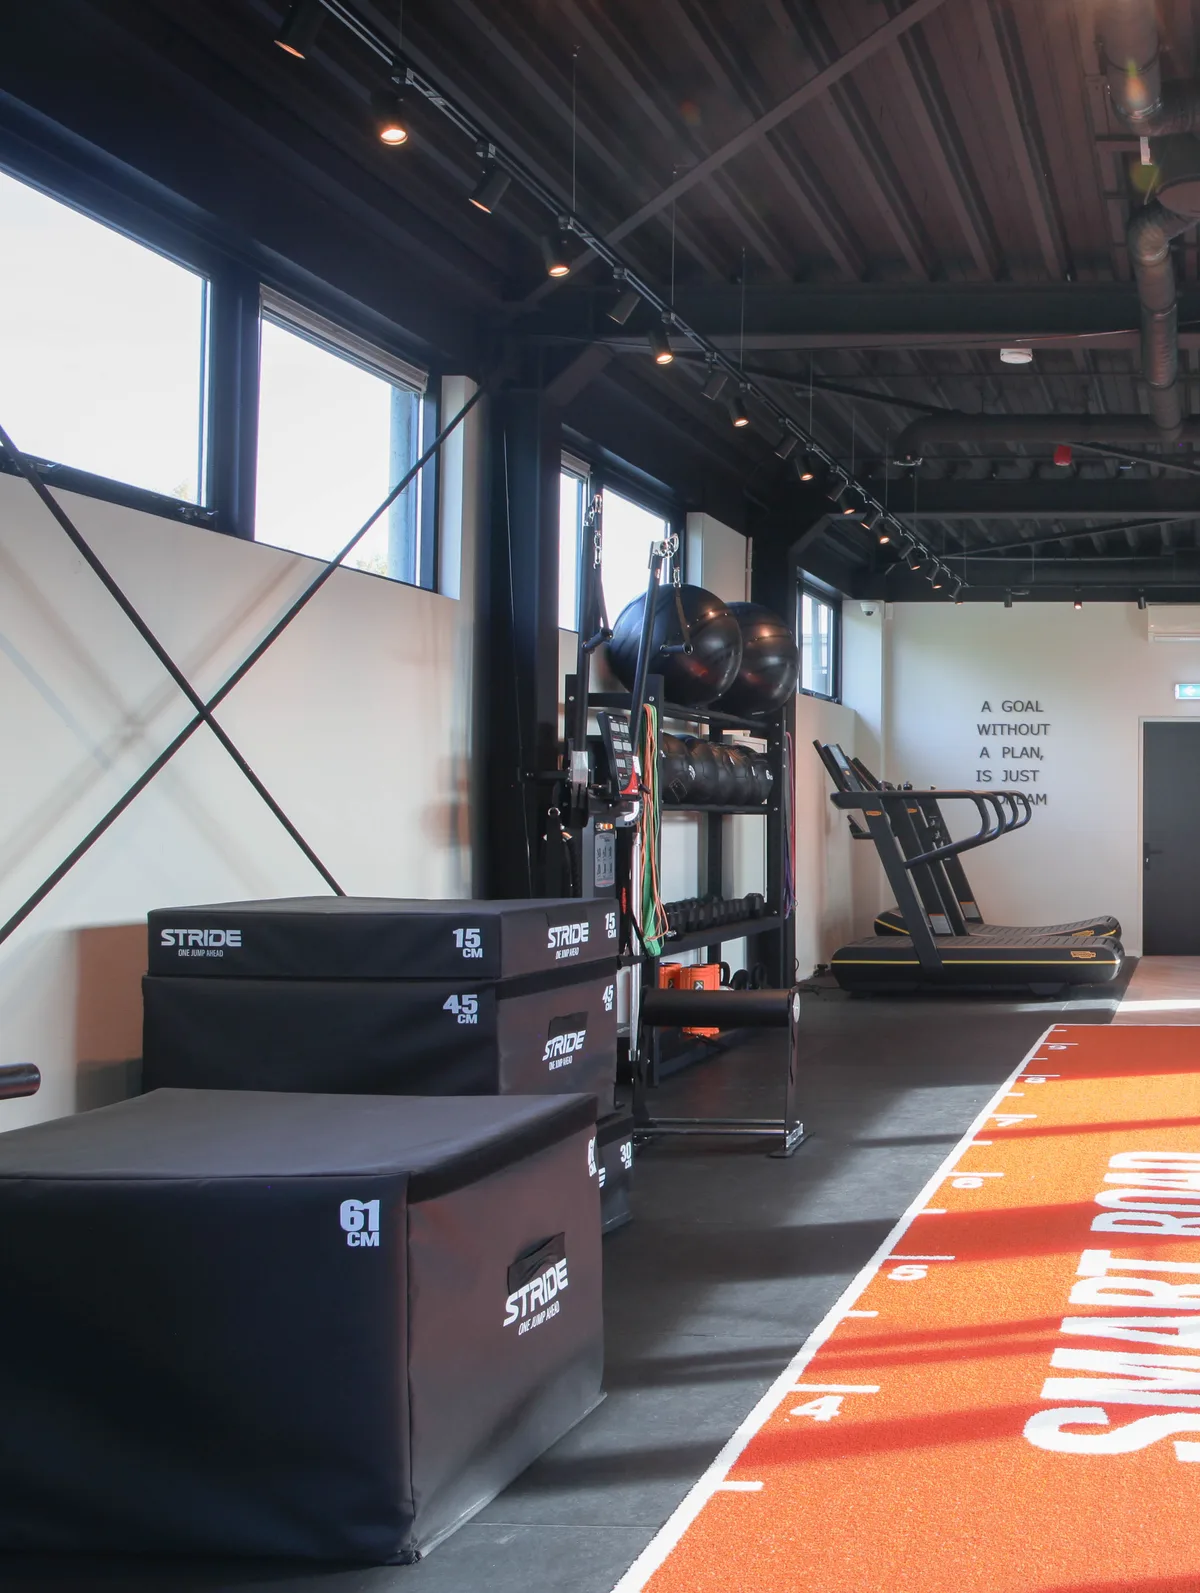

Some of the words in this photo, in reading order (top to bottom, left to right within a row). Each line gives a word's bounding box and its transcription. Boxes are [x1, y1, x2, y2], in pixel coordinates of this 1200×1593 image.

[980, 700, 992, 713] A
[1001, 700, 1044, 713] GOAL
[976, 723, 1051, 736] WITHOUT
[979, 746, 990, 759] A
[1002, 746, 1044, 761] PLAN,
[975, 769, 992, 783] IS
[1001, 769, 1040, 783] JUST
[605, 912, 616, 931] 15
[161, 928, 242, 947] STRIDE
[452, 928, 481, 948] 15
[547, 921, 589, 949] STRIDE
[178, 949, 190, 957] ONE
[190, 949, 206, 957] JUMP
[206, 949, 224, 958] AHEAD
[462, 948, 483, 958] CM
[602, 984, 614, 1004] 45
[442, 994, 478, 1014] 45
[457, 1014, 478, 1024] CM
[542, 1029, 587, 1061] STRIDE
[995, 1117, 1024, 1127] 7
[620, 1141, 632, 1163] 30
[951, 1177, 984, 1189] 6
[340, 1199, 380, 1231] 61
[347, 1231, 380, 1247] CM
[887, 1264, 929, 1281] 5
[503, 1257, 569, 1327] STRIDE
[518, 1318, 532, 1336] ONE
[530, 1310, 546, 1330] JUMP
[789, 1395, 845, 1422] 4
